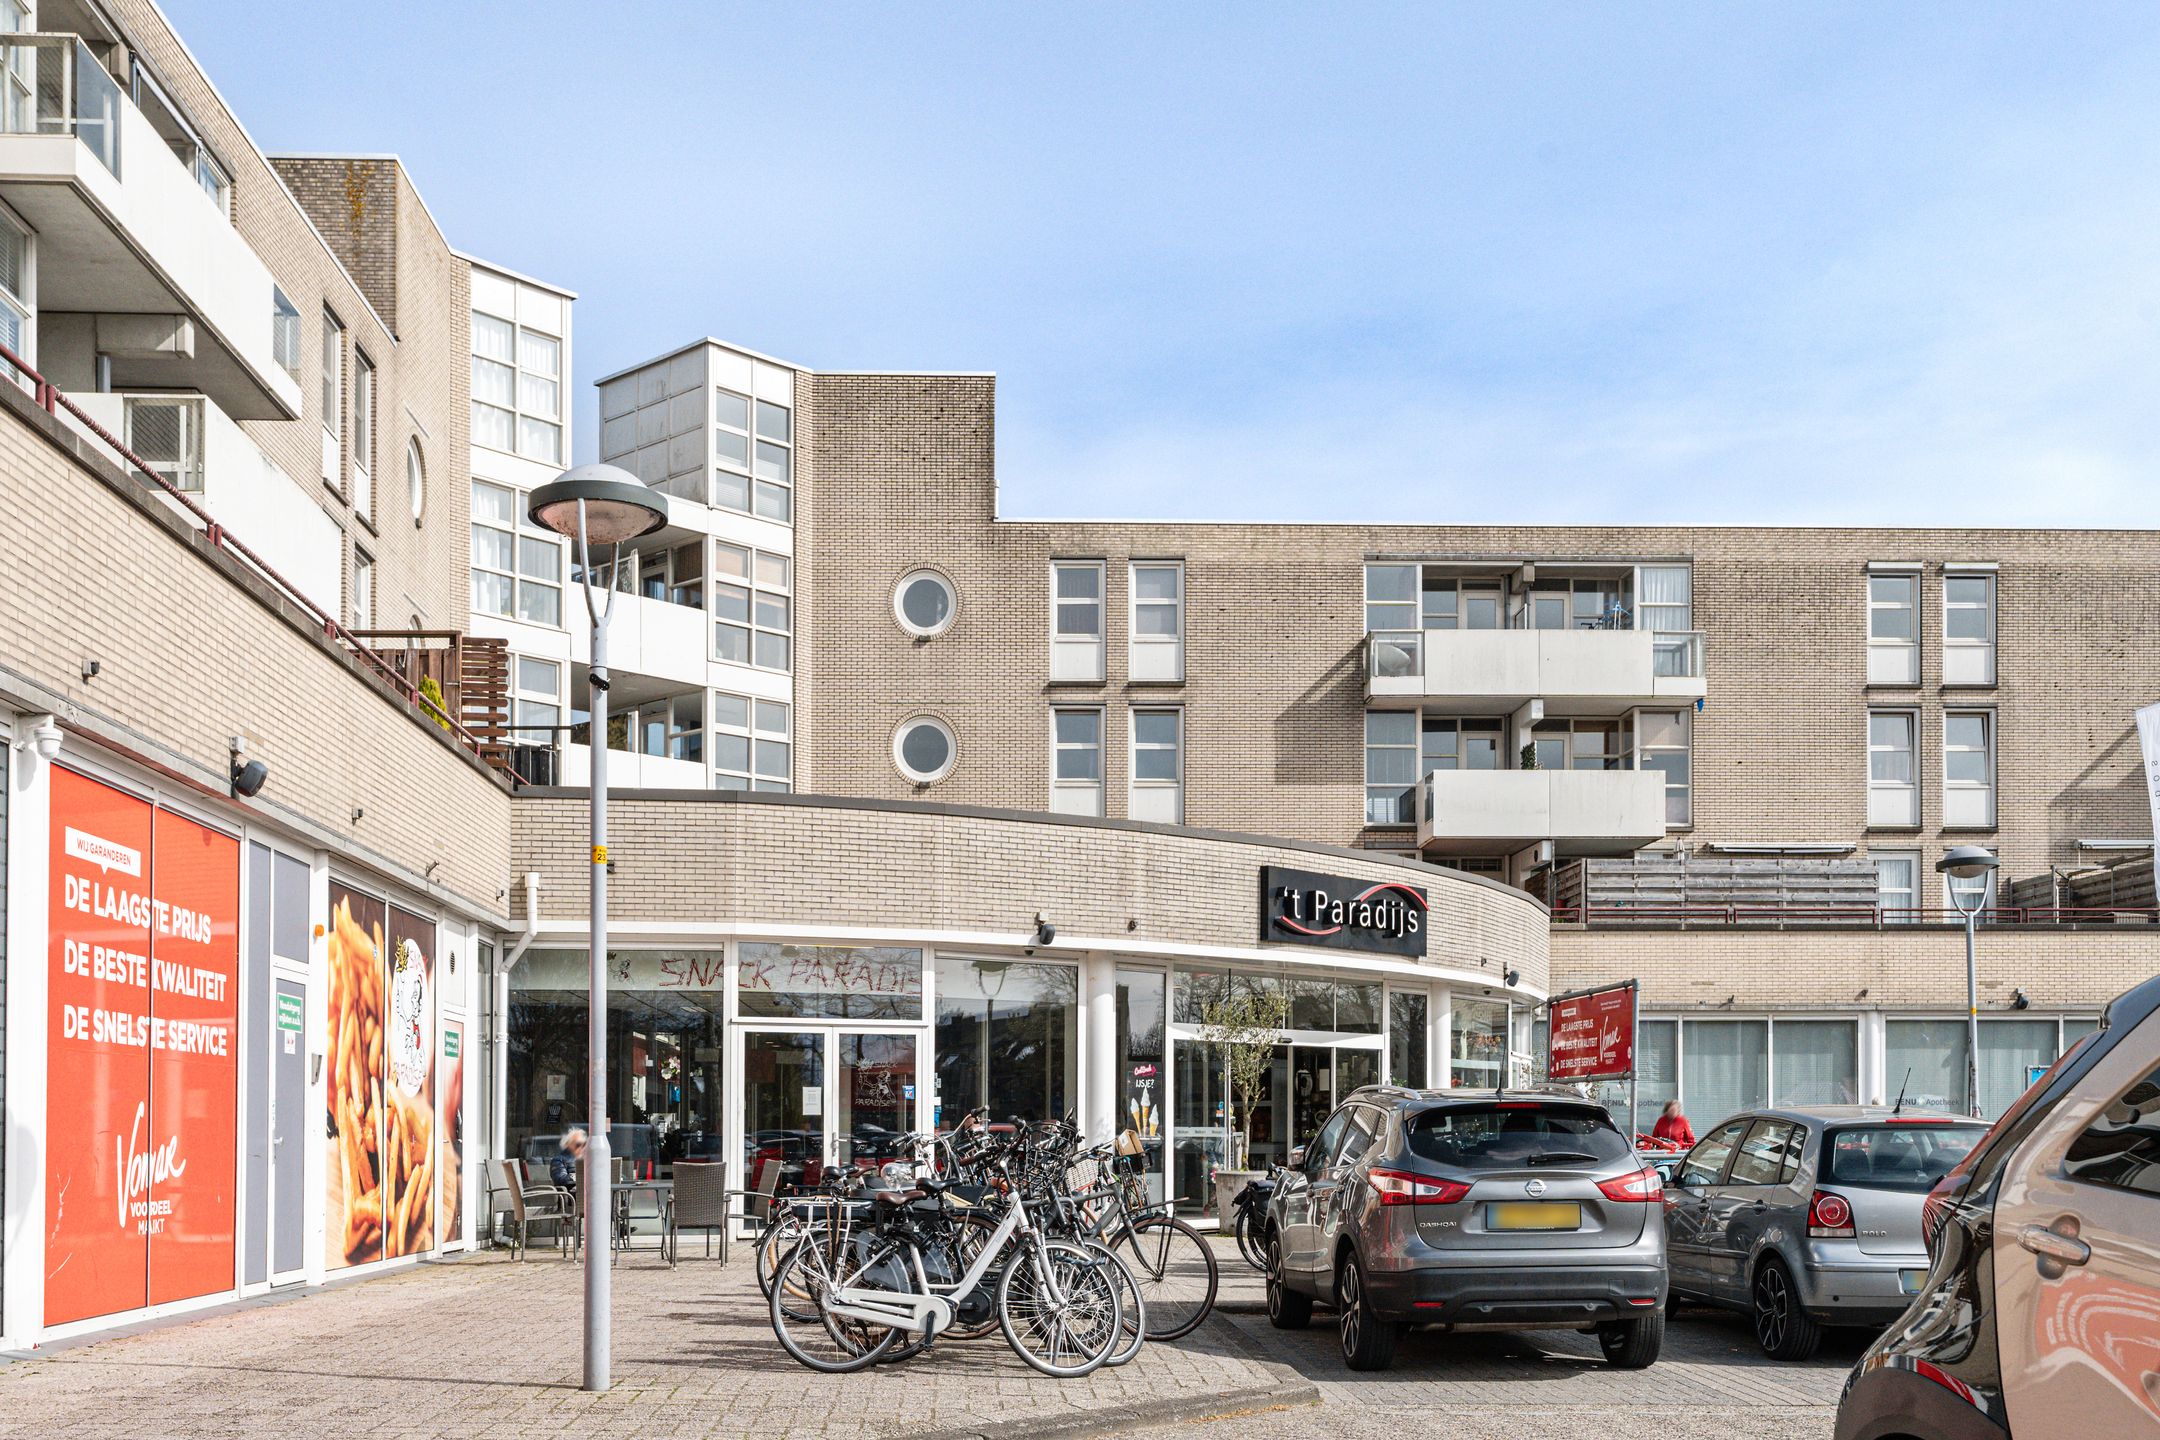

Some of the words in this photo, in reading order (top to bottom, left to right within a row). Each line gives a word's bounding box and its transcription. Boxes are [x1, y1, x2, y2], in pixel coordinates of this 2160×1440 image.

[76, 837, 89, 853] WIJ
[89, 842, 132, 867] GARANDEREN
[65, 873, 90, 913] DE
[94, 882, 170, 934] LAAGSTE
[172, 905, 212, 945] PRIJS
[1315, 889, 1419, 938] Paradijs
[64, 938, 90, 977] DE
[93, 945, 147, 988] BESTE
[152, 958, 227, 1002] KWALITEIT
[787, 958, 944, 995] PARADIS
[63, 1004, 90, 1041] DE
[92, 1008, 166, 1049] SNELSTE
[168, 1019, 228, 1057] SERVICE
[1925, 1097, 1960, 1107] Apotheek
[130, 1200, 173, 1217] VOORDEEL
[1861, 1230, 1888, 1238] POLO
